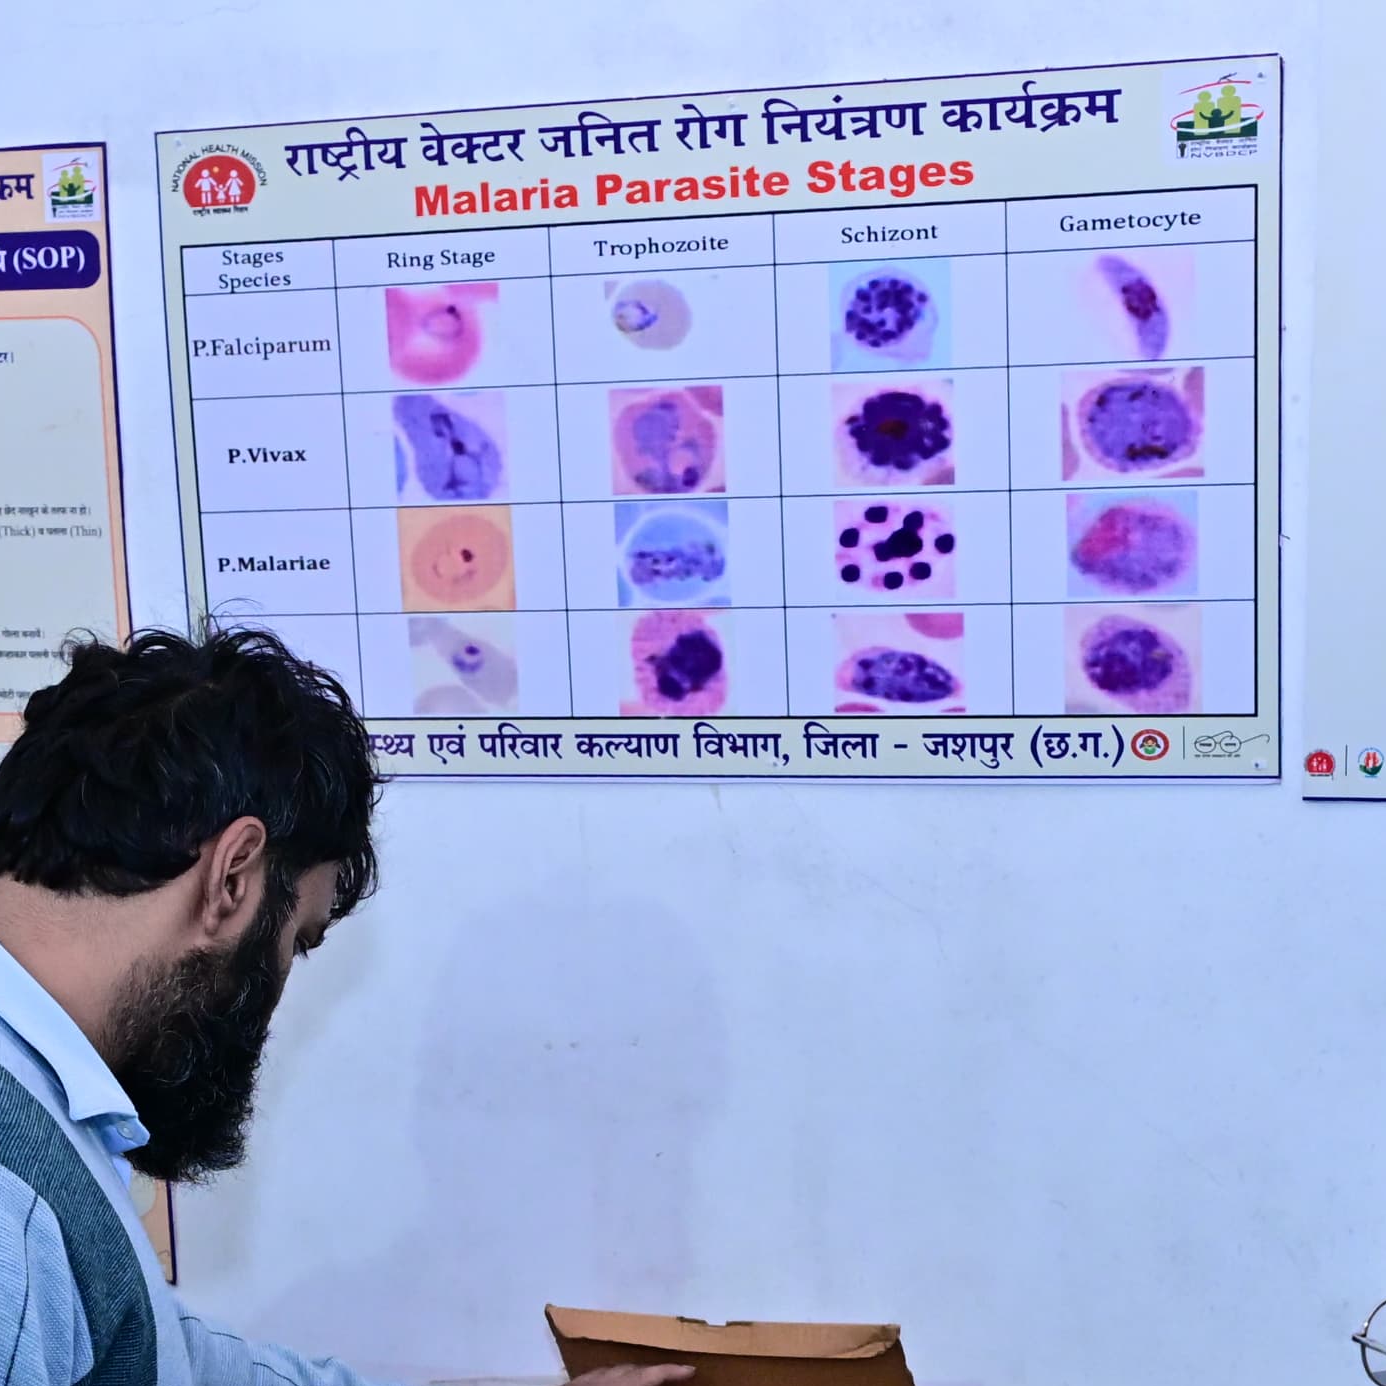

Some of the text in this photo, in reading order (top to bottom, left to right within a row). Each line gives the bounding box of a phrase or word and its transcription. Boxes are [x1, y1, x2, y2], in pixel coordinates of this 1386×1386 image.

[285, 81, 1122, 181] राष्ट्रीय वेक्टर जनित रोग नियंत्रण कार्यक्रम
[172, 144, 268, 193] NATIONAL HEALTH MISSION
[415, 160, 973, 216] Malaria Parasite Stages
[1060, 212, 1201, 232] Gametocyte
[842, 226, 937, 243] Schizont
[594, 236, 728, 259] Trophozoite
[13, 246, 85, 273] (SOP)
[223, 250, 283, 268] Stages
[388, 250, 495, 270] Ring Stage
[218, 272, 292, 293] Species
[194, 337, 330, 360] P.Falciparum
[229, 448, 306, 463] P.Vivax
[218, 556, 330, 572] P.Malariae
[427, 722, 1124, 769] एवं परिवार कल्याण विभाग, जिला जशपुर (छ.ग.)
